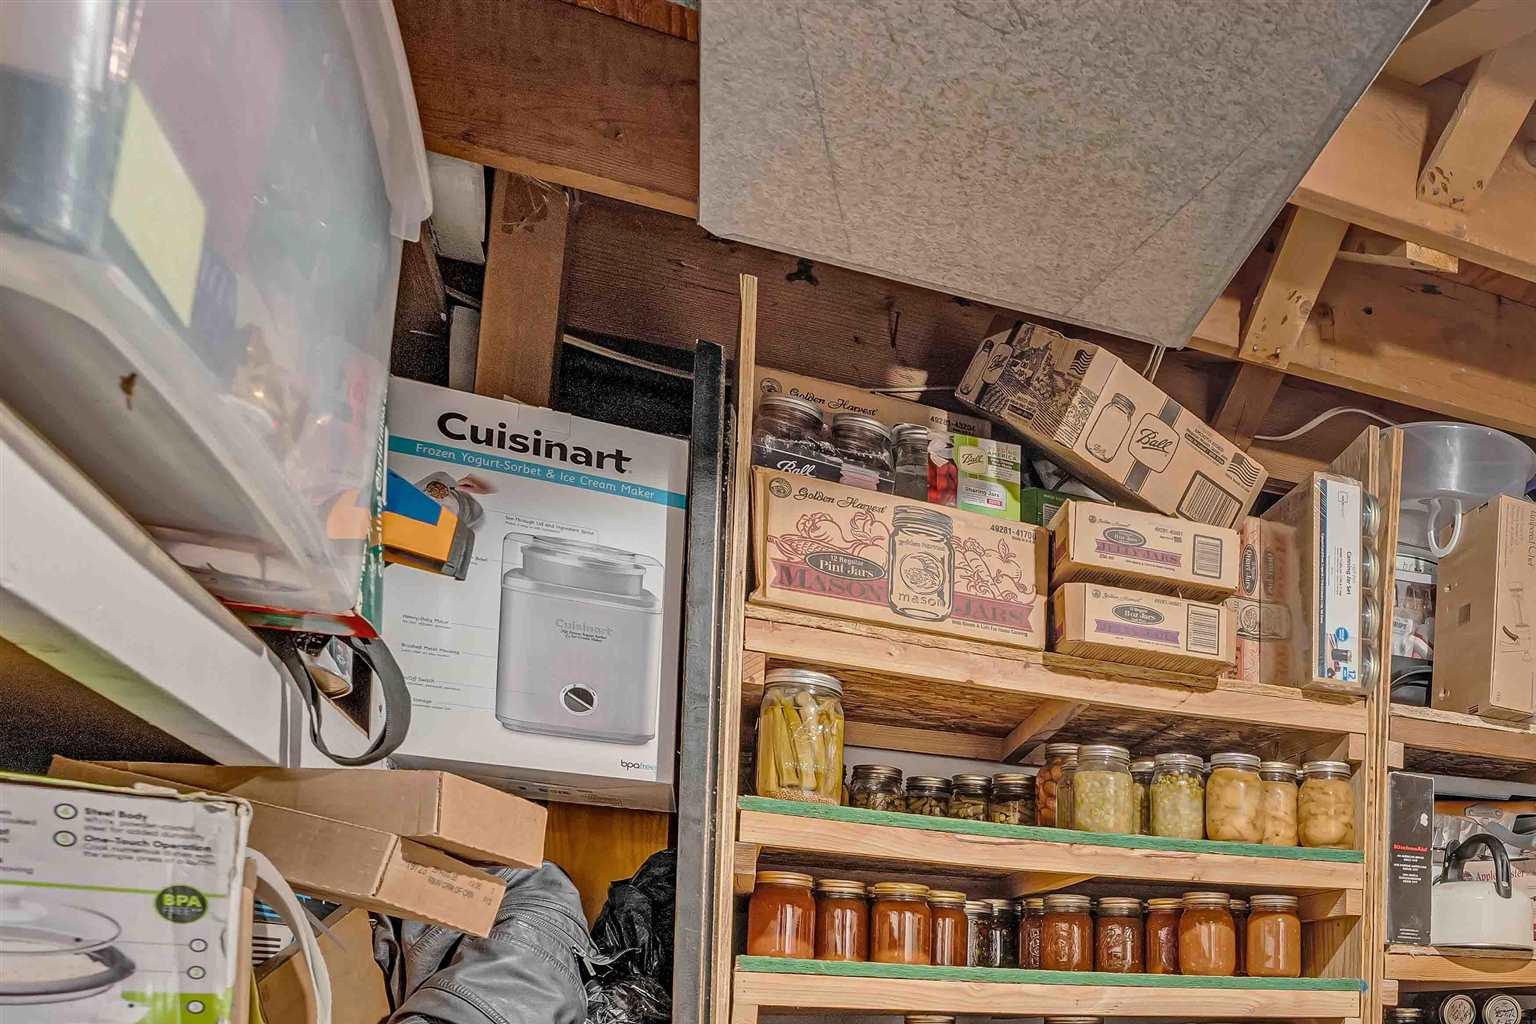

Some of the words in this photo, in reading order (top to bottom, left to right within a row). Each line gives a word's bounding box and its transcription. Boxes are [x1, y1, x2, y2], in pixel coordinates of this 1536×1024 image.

[436, 411, 632, 474] Cuisinart
[1136, 429, 1174, 452] Ball
[415, 442, 456, 460] Frozen
[461, 453, 541, 475] Yogurt-Sorbet
[545, 468, 556, 479] &
[559, 471, 576, 483] Ice
[579, 475, 618, 492] Cream
[620, 482, 656, 498] Maker
[961, 453, 984, 465] Ball
[794, 487, 834, 504] Golden
[837, 492, 888, 513] Harvest
[819, 561, 847, 574] Pint
[850, 566, 875, 577] Jars
[162, 894, 202, 908] BPA
